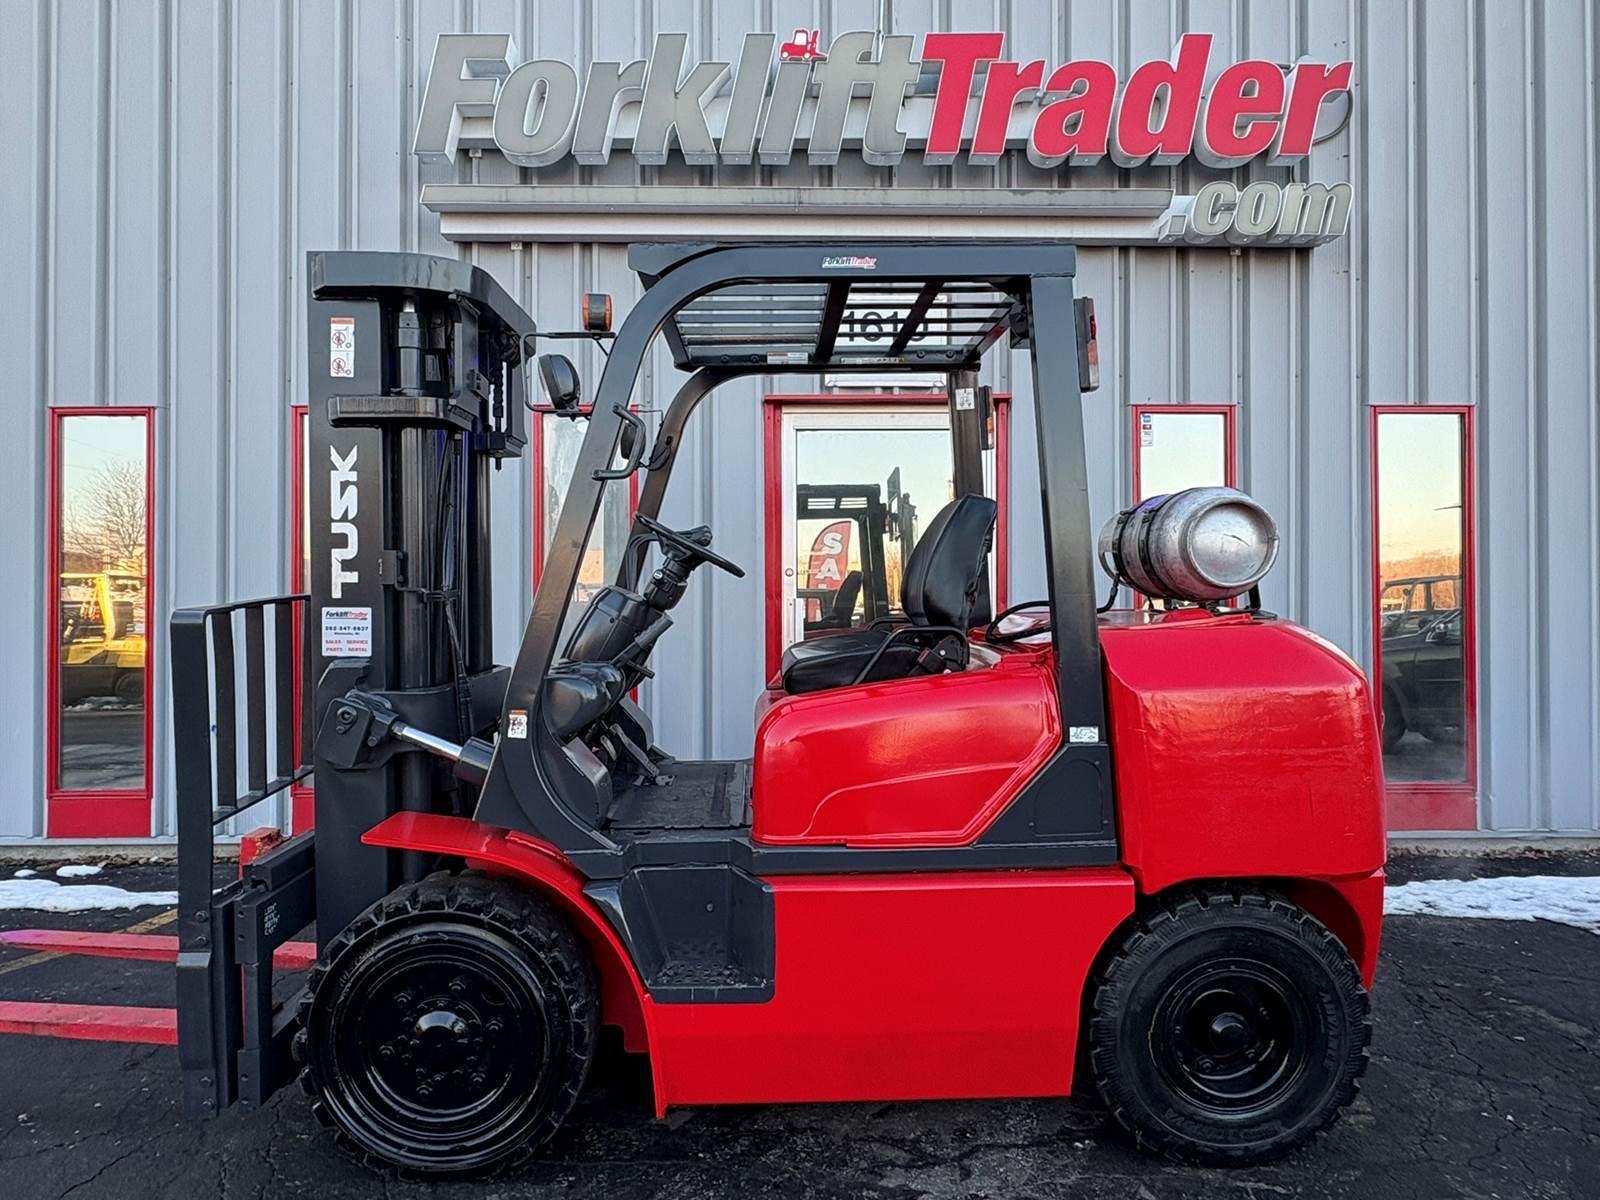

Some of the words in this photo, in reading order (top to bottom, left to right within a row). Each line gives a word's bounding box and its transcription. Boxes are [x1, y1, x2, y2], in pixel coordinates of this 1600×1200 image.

[412, 31, 1354, 161] ForkliftTrader
[1166, 180, 1354, 236] .com
[330, 445, 359, 599] TUSK
